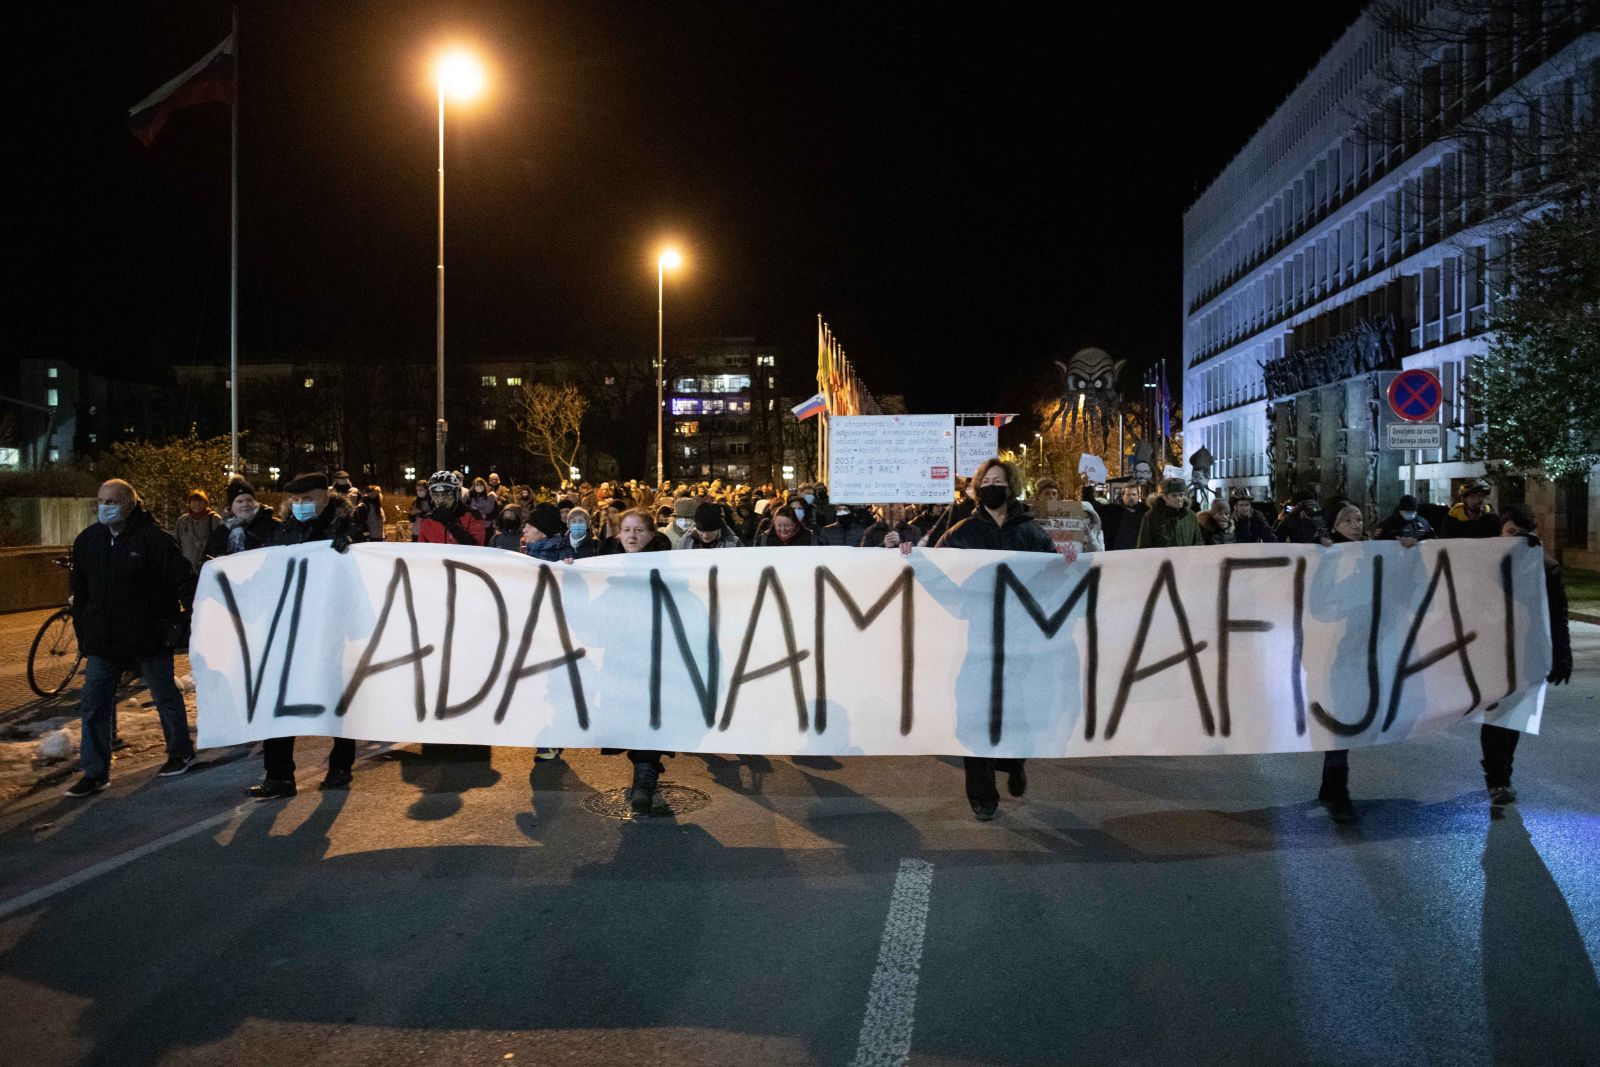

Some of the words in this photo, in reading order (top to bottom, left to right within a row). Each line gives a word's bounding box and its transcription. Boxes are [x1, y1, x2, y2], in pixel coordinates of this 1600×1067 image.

[1391, 437, 1416, 445] Državnega
[216, 556, 590, 731] VLADA
[650, 565, 915, 735] NAM
[989, 548, 1515, 746] MAFIJA!
